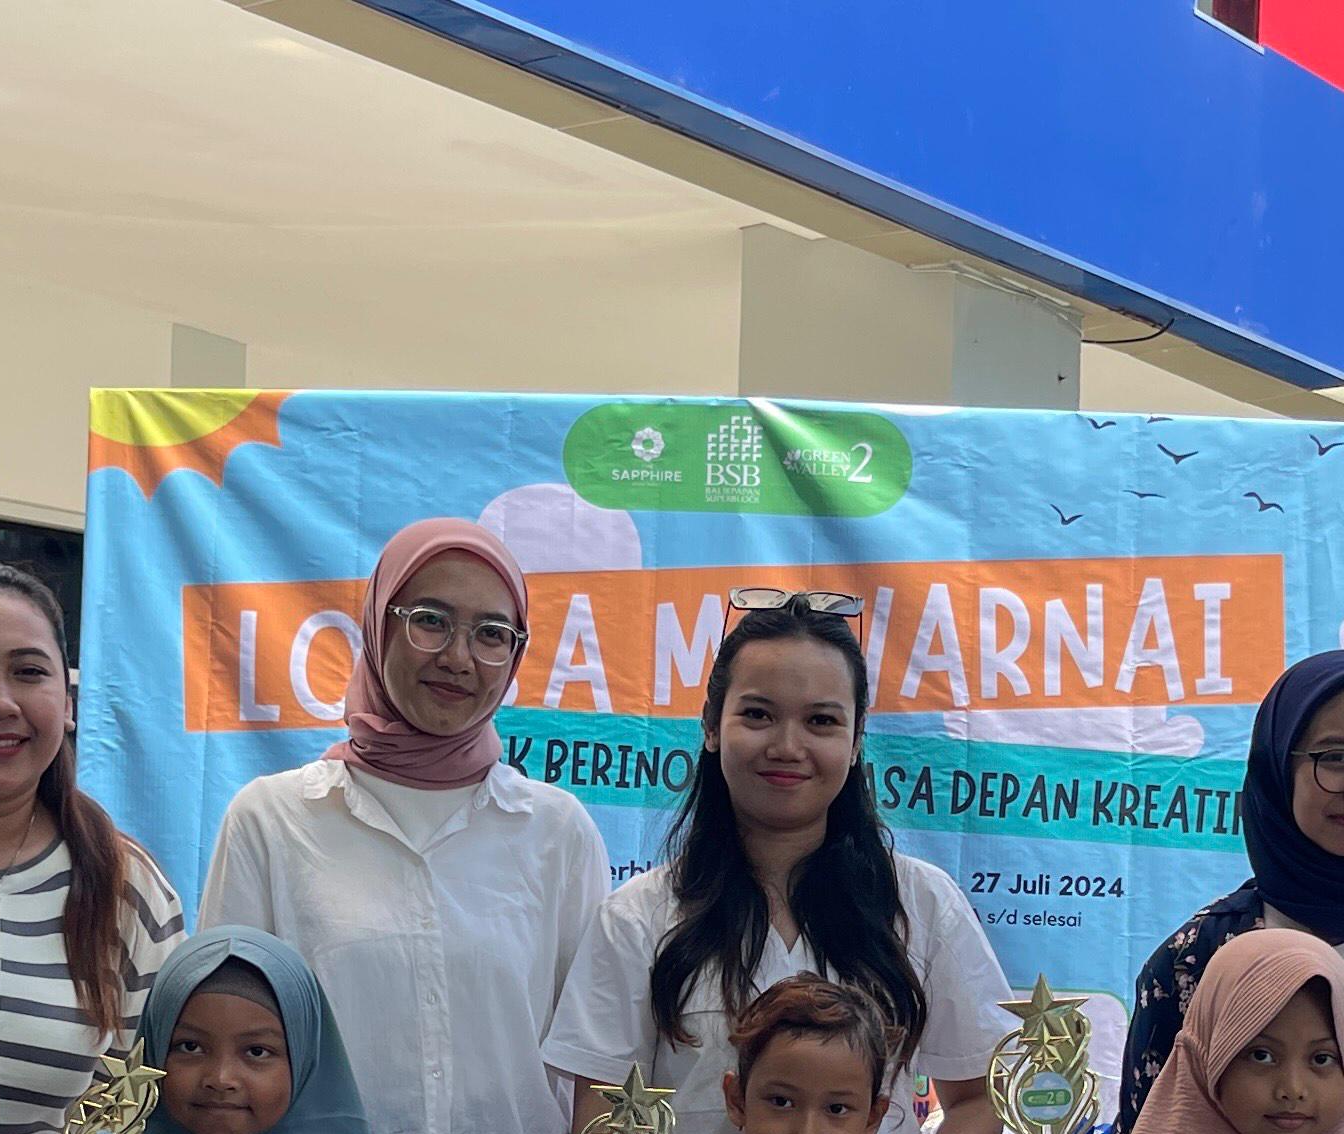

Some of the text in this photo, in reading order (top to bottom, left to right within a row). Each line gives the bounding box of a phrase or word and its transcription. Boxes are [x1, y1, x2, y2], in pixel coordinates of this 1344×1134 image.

[611, 468, 682, 483] SAPPHIRE
[705, 463, 761, 488] BSB
[847, 442, 874, 483] 2
[238, 577, 1232, 723] LOA MARNAI
[544, 739, 694, 793] BERINO
[864, 762, 935, 816] SA
[950, 770, 1080, 824] DEPAN
[970, 872, 1125, 899] 27 Juli 2024
[987, 908, 1019, 926] s/d
[1022, 909, 1083, 928] selesai
